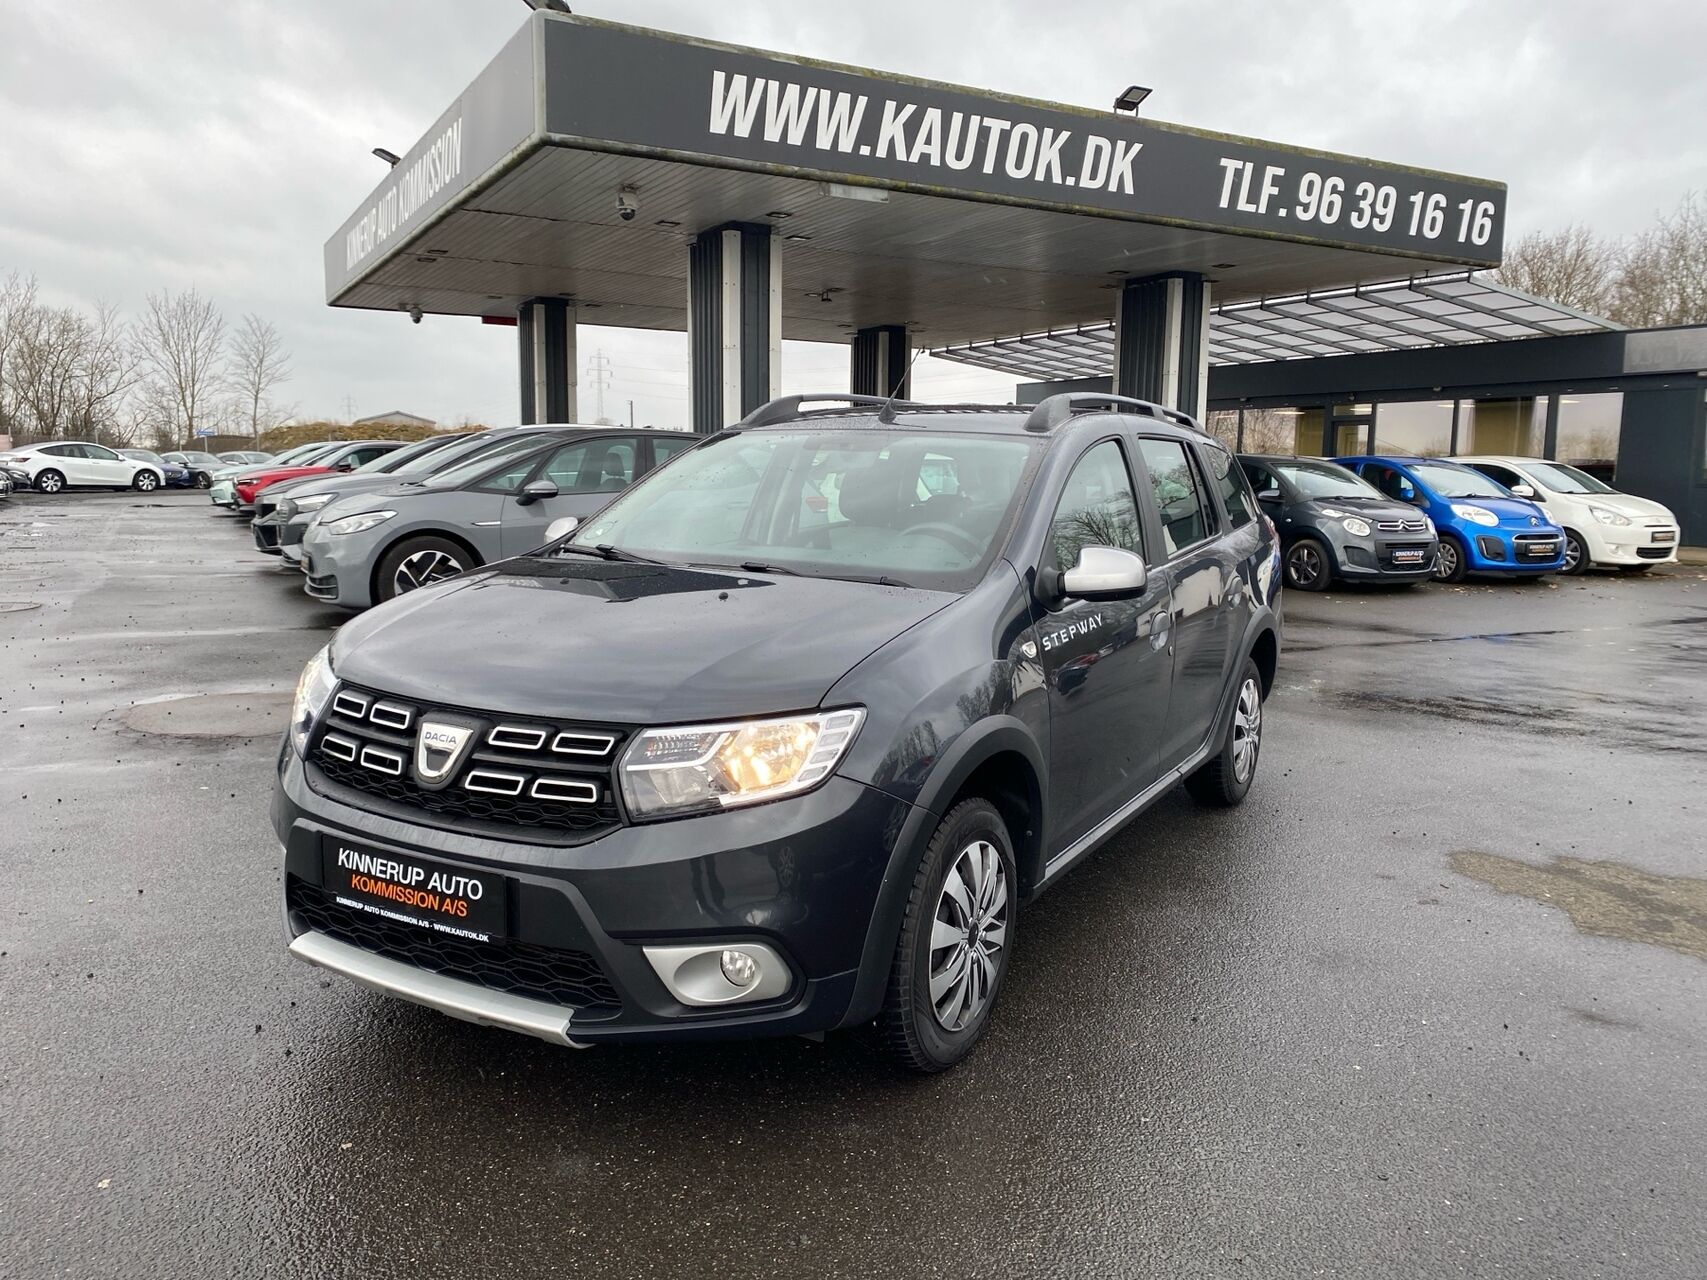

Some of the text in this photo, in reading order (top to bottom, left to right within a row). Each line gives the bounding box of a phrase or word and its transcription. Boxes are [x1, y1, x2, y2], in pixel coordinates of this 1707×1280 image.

[709, 70, 1144, 196] WWW.KAUTOK.DK
[377, 185, 397, 245] AUTO
[399, 117, 462, 226] KOMMISSION
[1219, 157, 1495, 246] TLF. 96 39 16 16
[1042, 613, 1102, 651] STEPWAY
[425, 731, 457, 744] DACIA
[338, 847, 483, 900] KINNERUP AUTO
[351, 874, 468, 917] KOMMISSION A/S
[336, 896, 364, 910] KINNERUP
[364, 904, 380, 915] AUTO
[380, 909, 418, 926] KOMMISSION
[418, 919, 430, 929] A/S
[433, 923, 490, 943] WWW.KAUTOK.DK
